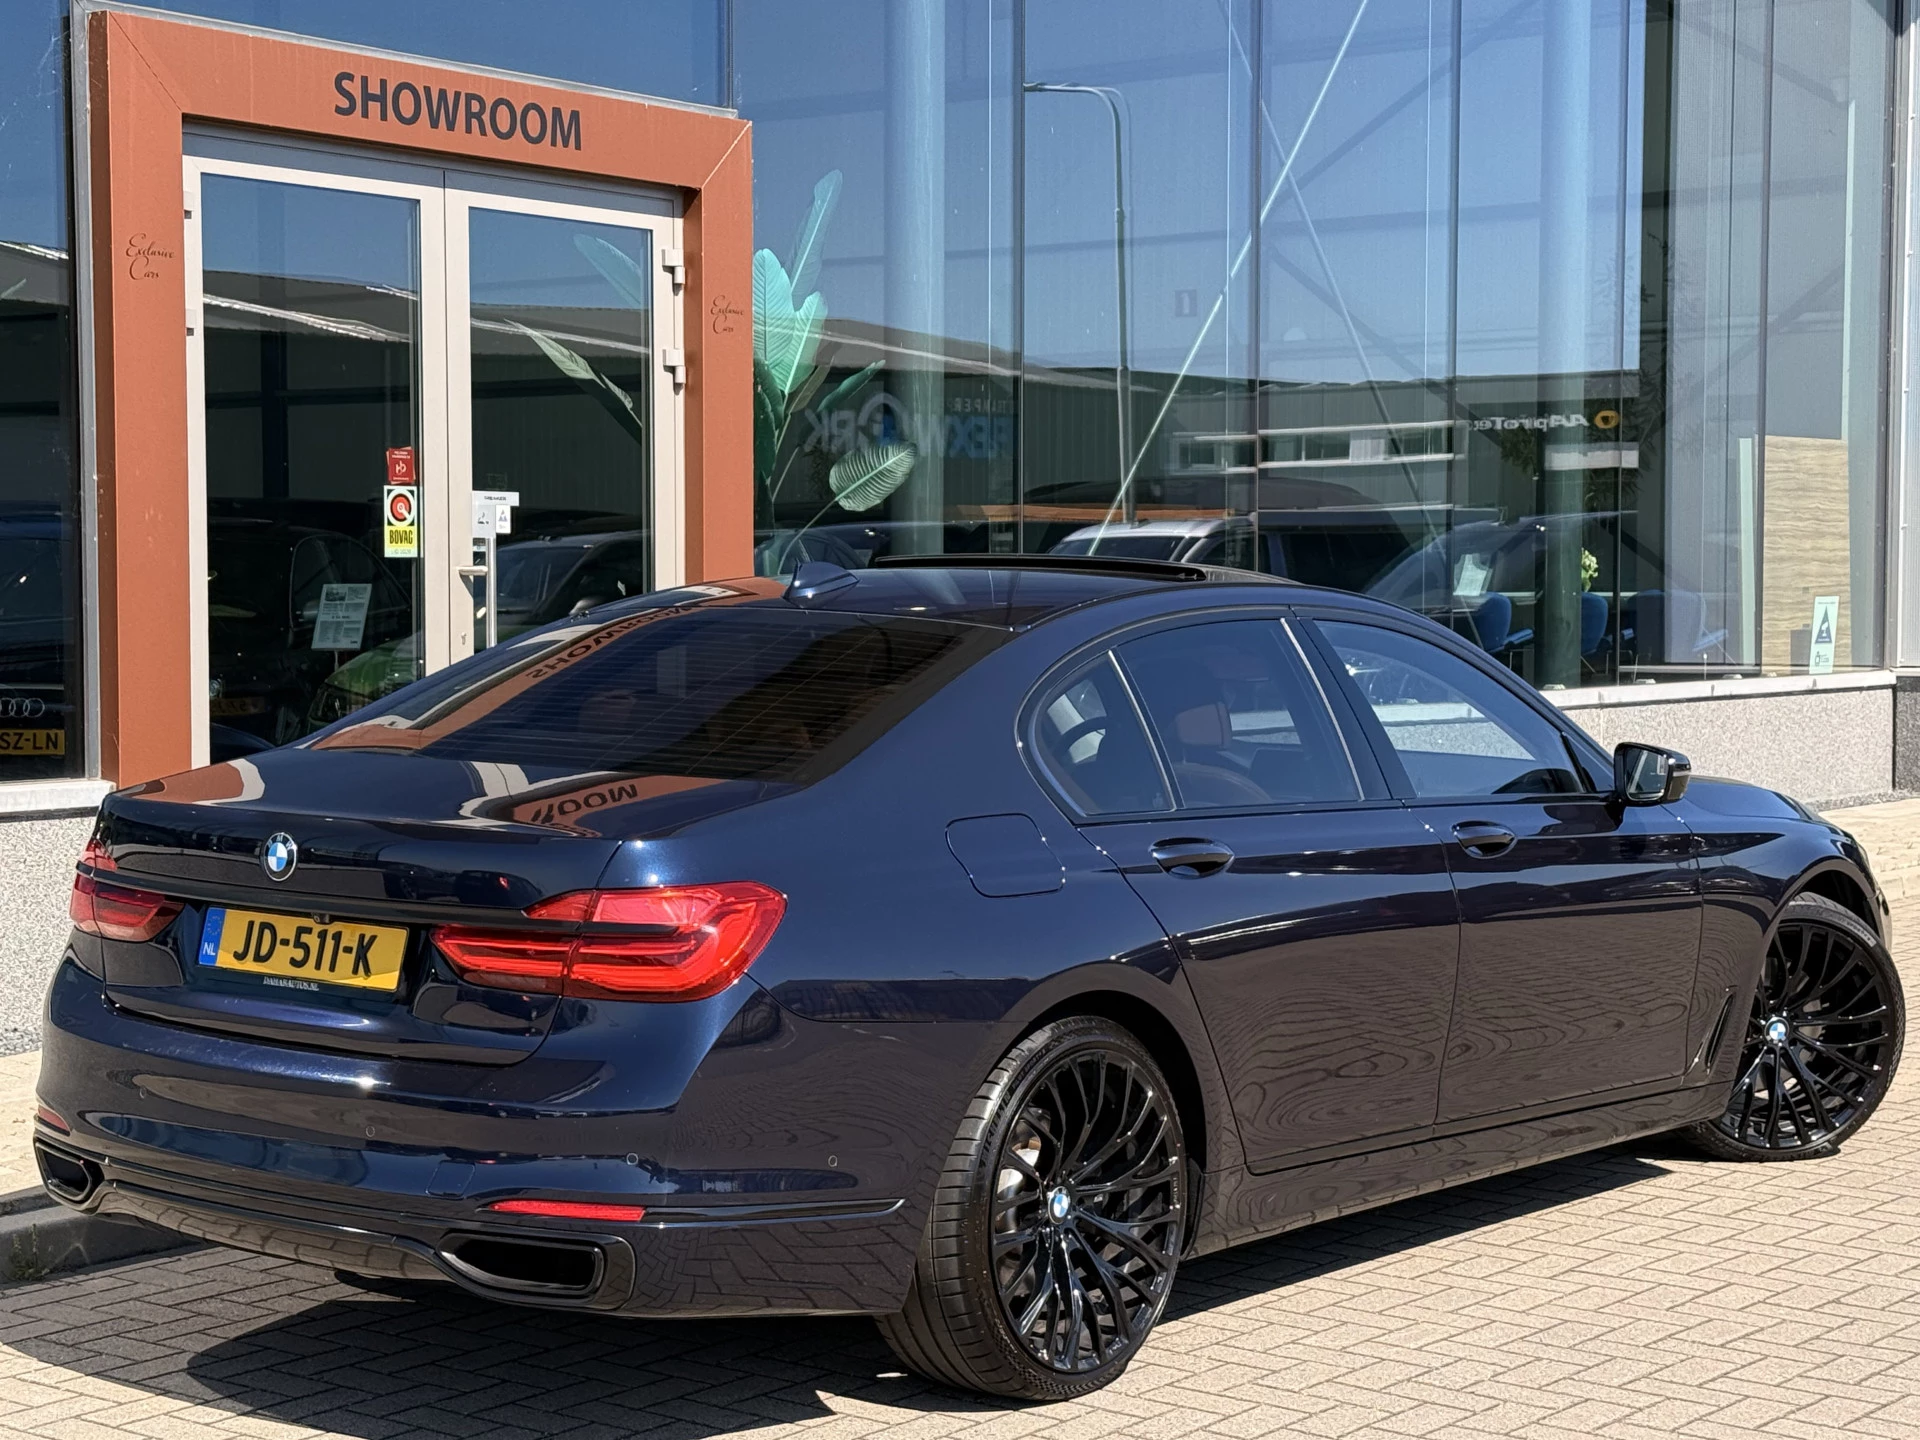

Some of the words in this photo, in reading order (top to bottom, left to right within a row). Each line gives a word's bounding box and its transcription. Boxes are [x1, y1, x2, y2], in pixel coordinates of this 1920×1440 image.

[334, 71, 582, 151] SHOWROOM
[126, 233, 176, 258] Exclusive
[129, 256, 160, 280] Cars
[389, 529, 414, 545] BOVAG
[203, 942, 216, 956] NL
[233, 920, 378, 978] JD-511-K
